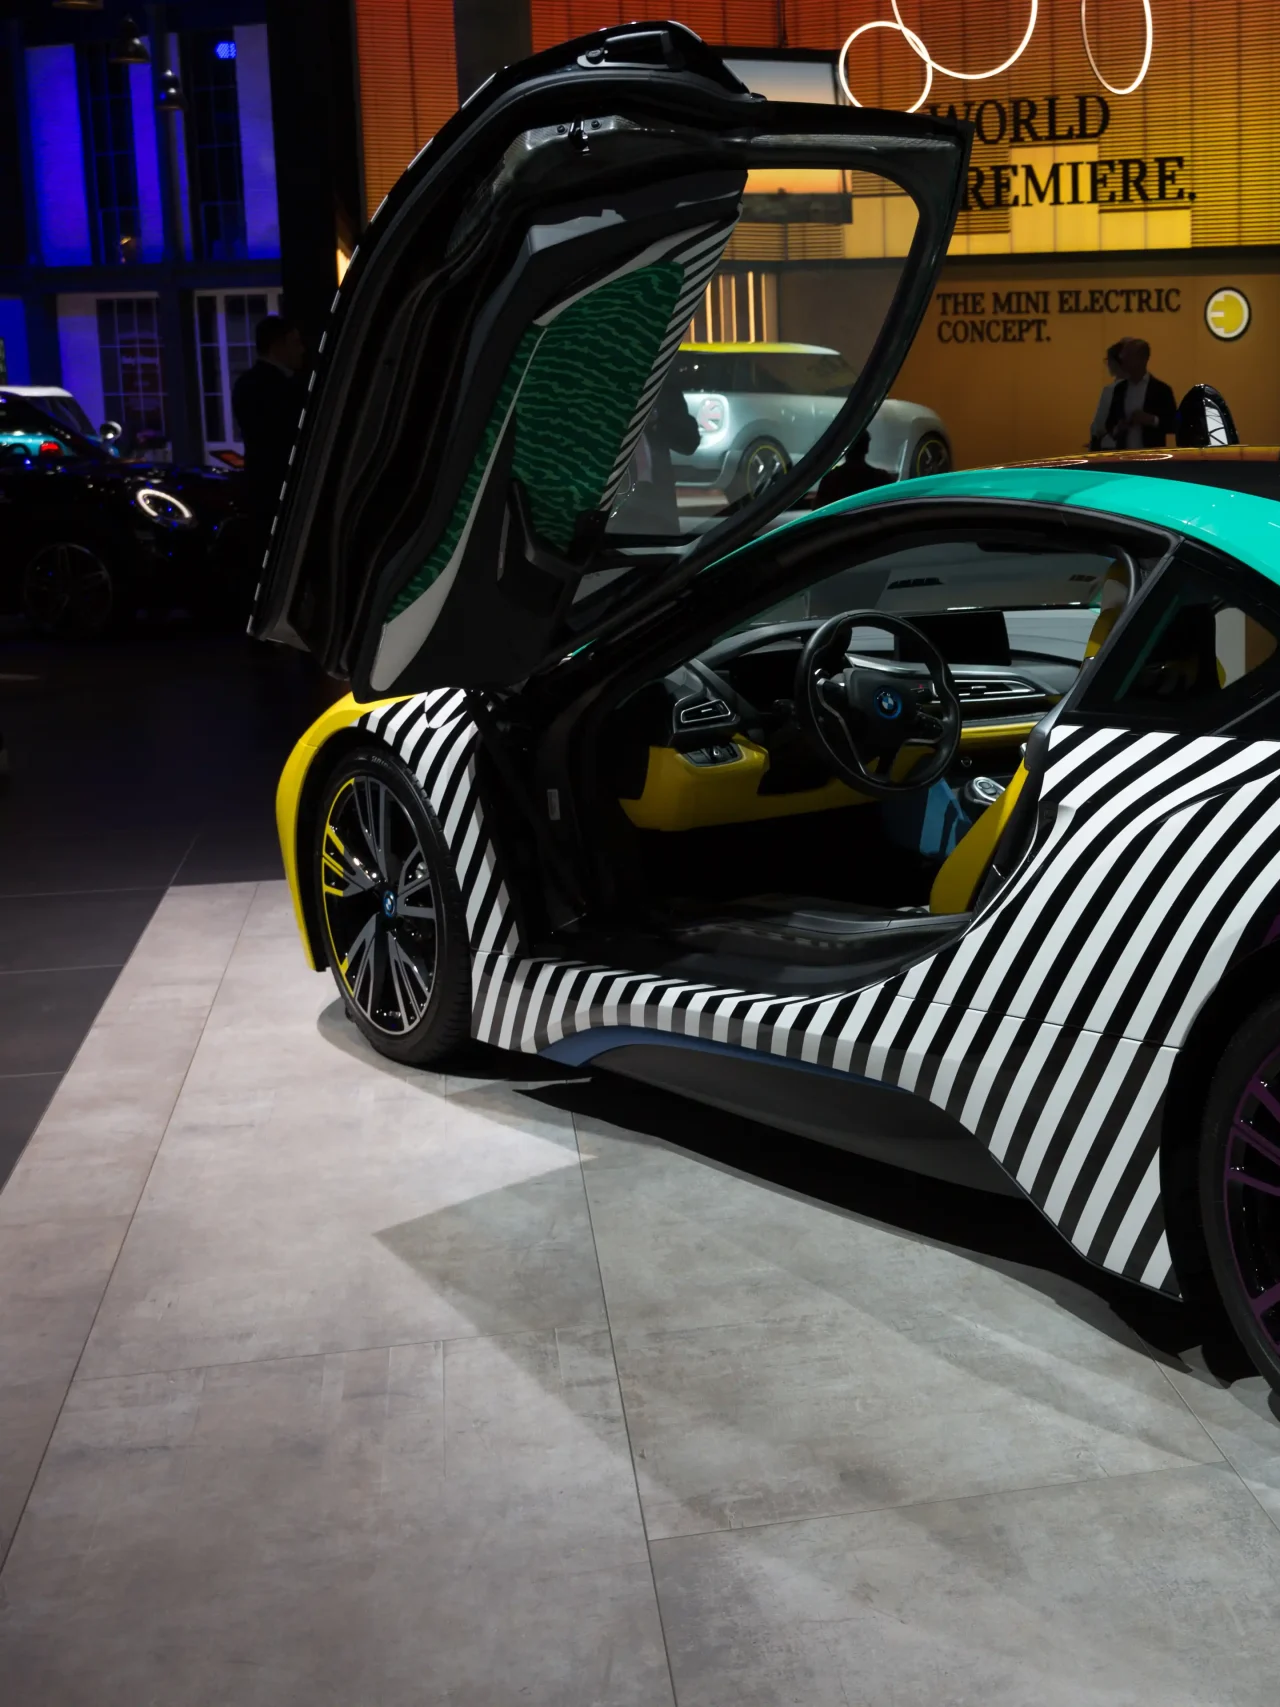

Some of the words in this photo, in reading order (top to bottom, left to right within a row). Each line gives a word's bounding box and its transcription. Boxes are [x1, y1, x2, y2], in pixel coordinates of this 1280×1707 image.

[960, 156, 1197, 211] REMIERE.
[936, 291, 985, 315] THE
[991, 290, 1050, 314] MINI
[1057, 288, 1182, 314] ELECTRIC
[937, 318, 1052, 343] CONCEPT.
